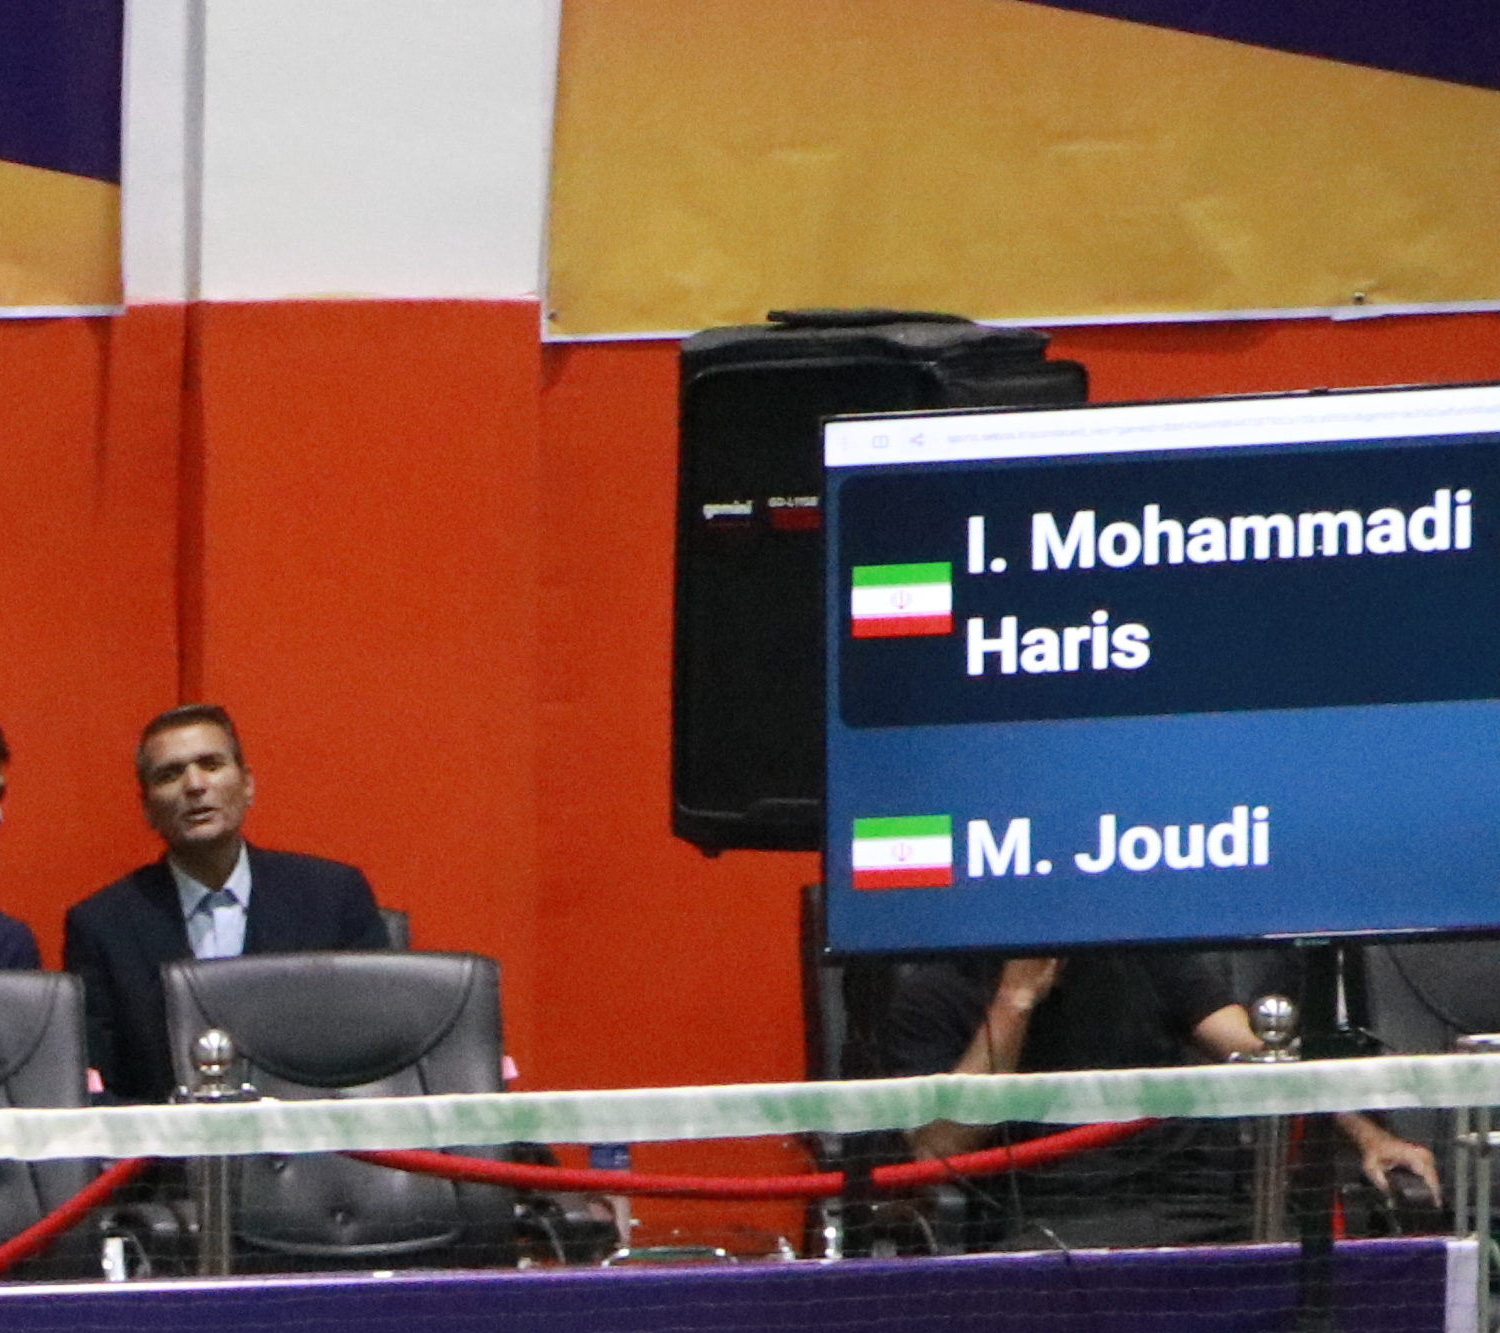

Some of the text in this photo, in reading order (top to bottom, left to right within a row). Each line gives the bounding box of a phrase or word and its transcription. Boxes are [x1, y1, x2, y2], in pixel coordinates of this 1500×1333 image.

[966, 488, 1474, 575] I. Mohammadi
[966, 609, 1152, 677] Haris
[966, 804, 1271, 879] M. Joudi
